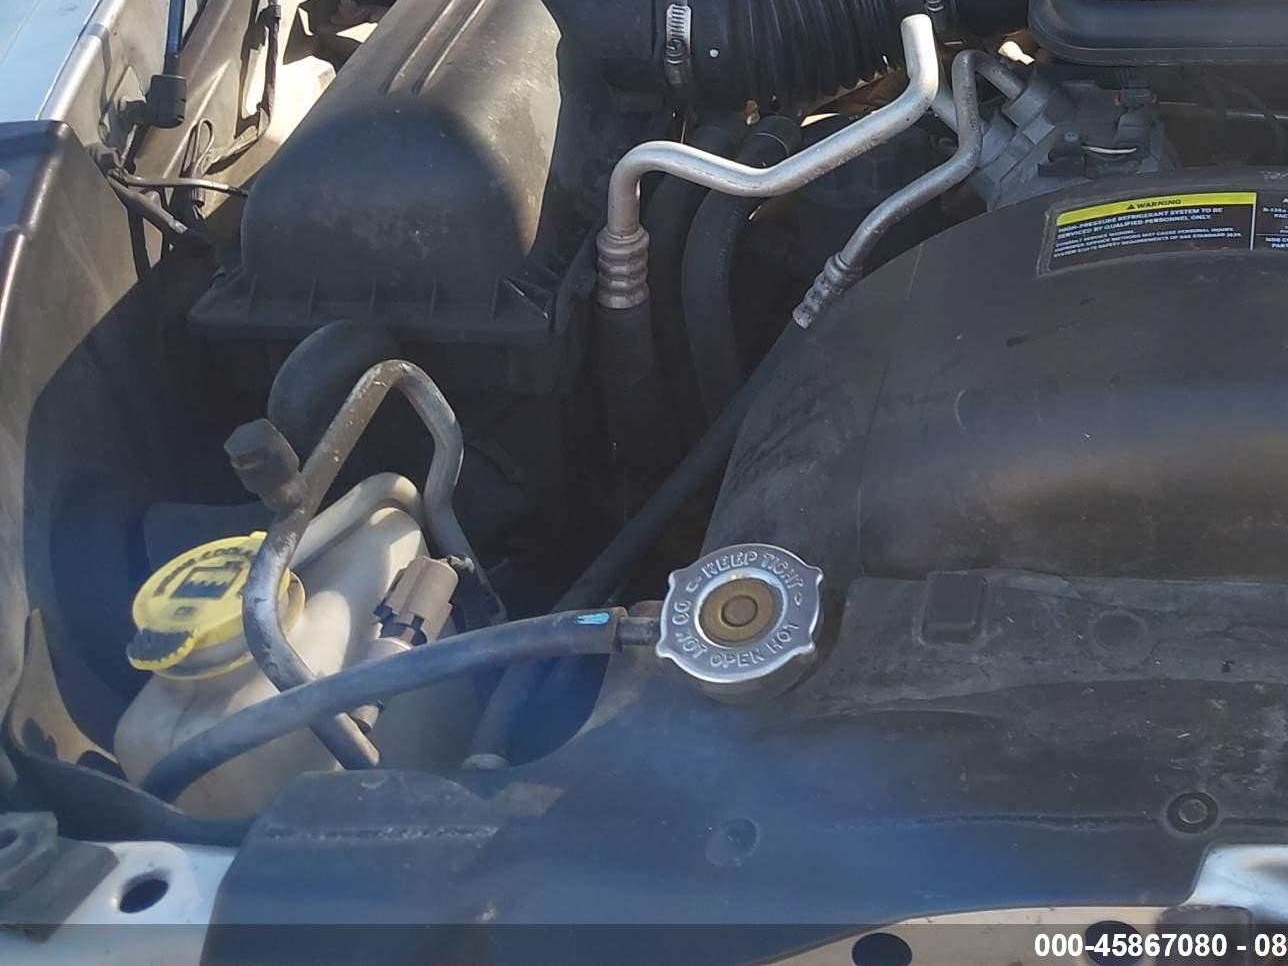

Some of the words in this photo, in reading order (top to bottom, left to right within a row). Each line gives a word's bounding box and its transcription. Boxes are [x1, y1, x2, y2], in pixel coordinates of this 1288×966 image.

[1118, 211, 1169, 222] REFRIGERANT
[1170, 208, 1200, 216] SYSTEM
[1137, 199, 1181, 209] WARNING
[1057, 228, 1092, 239] SERVICED
[1104, 220, 1144, 230] QUALIFIED
[1145, 216, 1190, 225] PERSONNEL
[701, 551, 757, 578] KEEP
[761, 553, 804, 589] TIGHT
[710, 648, 766, 668] OPEN
[765, 622, 801, 654] HOT
